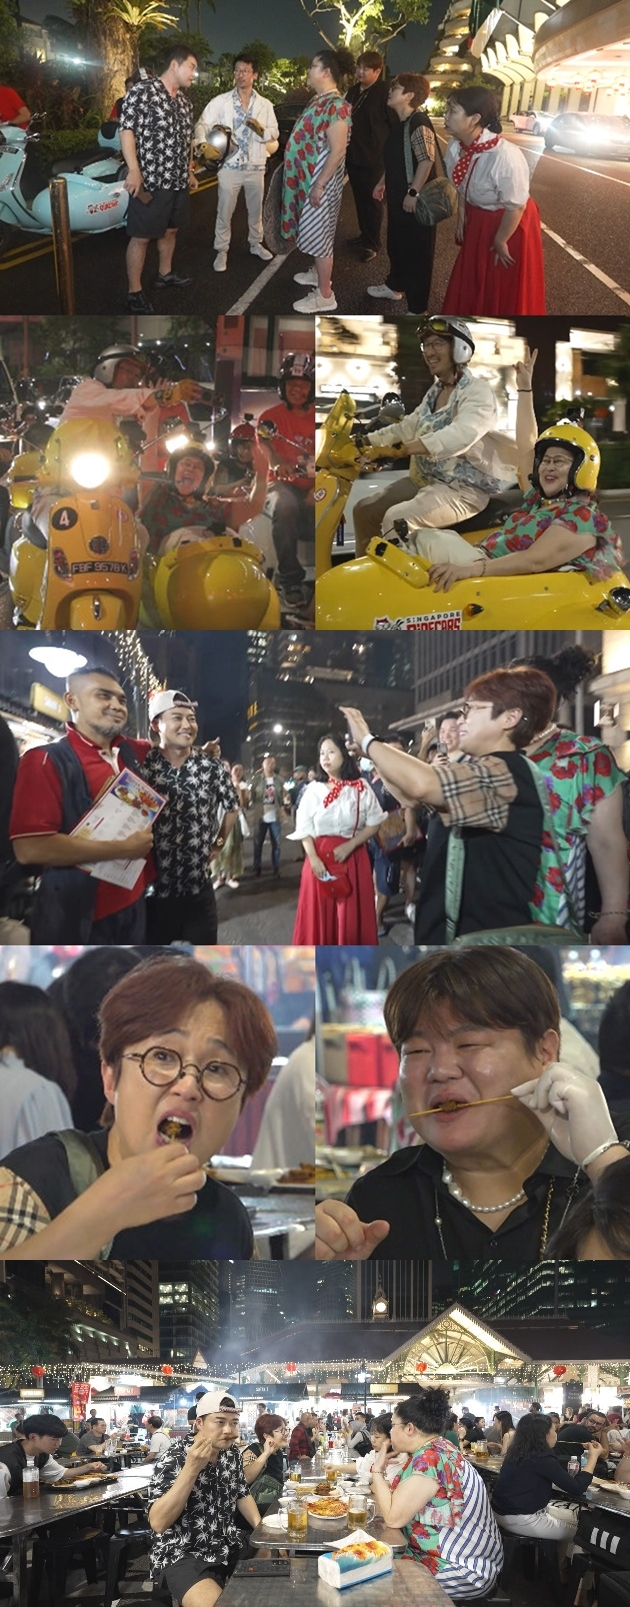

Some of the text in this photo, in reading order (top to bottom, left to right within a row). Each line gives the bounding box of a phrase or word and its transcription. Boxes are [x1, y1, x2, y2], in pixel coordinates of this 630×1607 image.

[59, 510, 70, 526] 4
[72, 562, 92, 573] FBF
[406, 611, 460, 623] SINGAPORE
